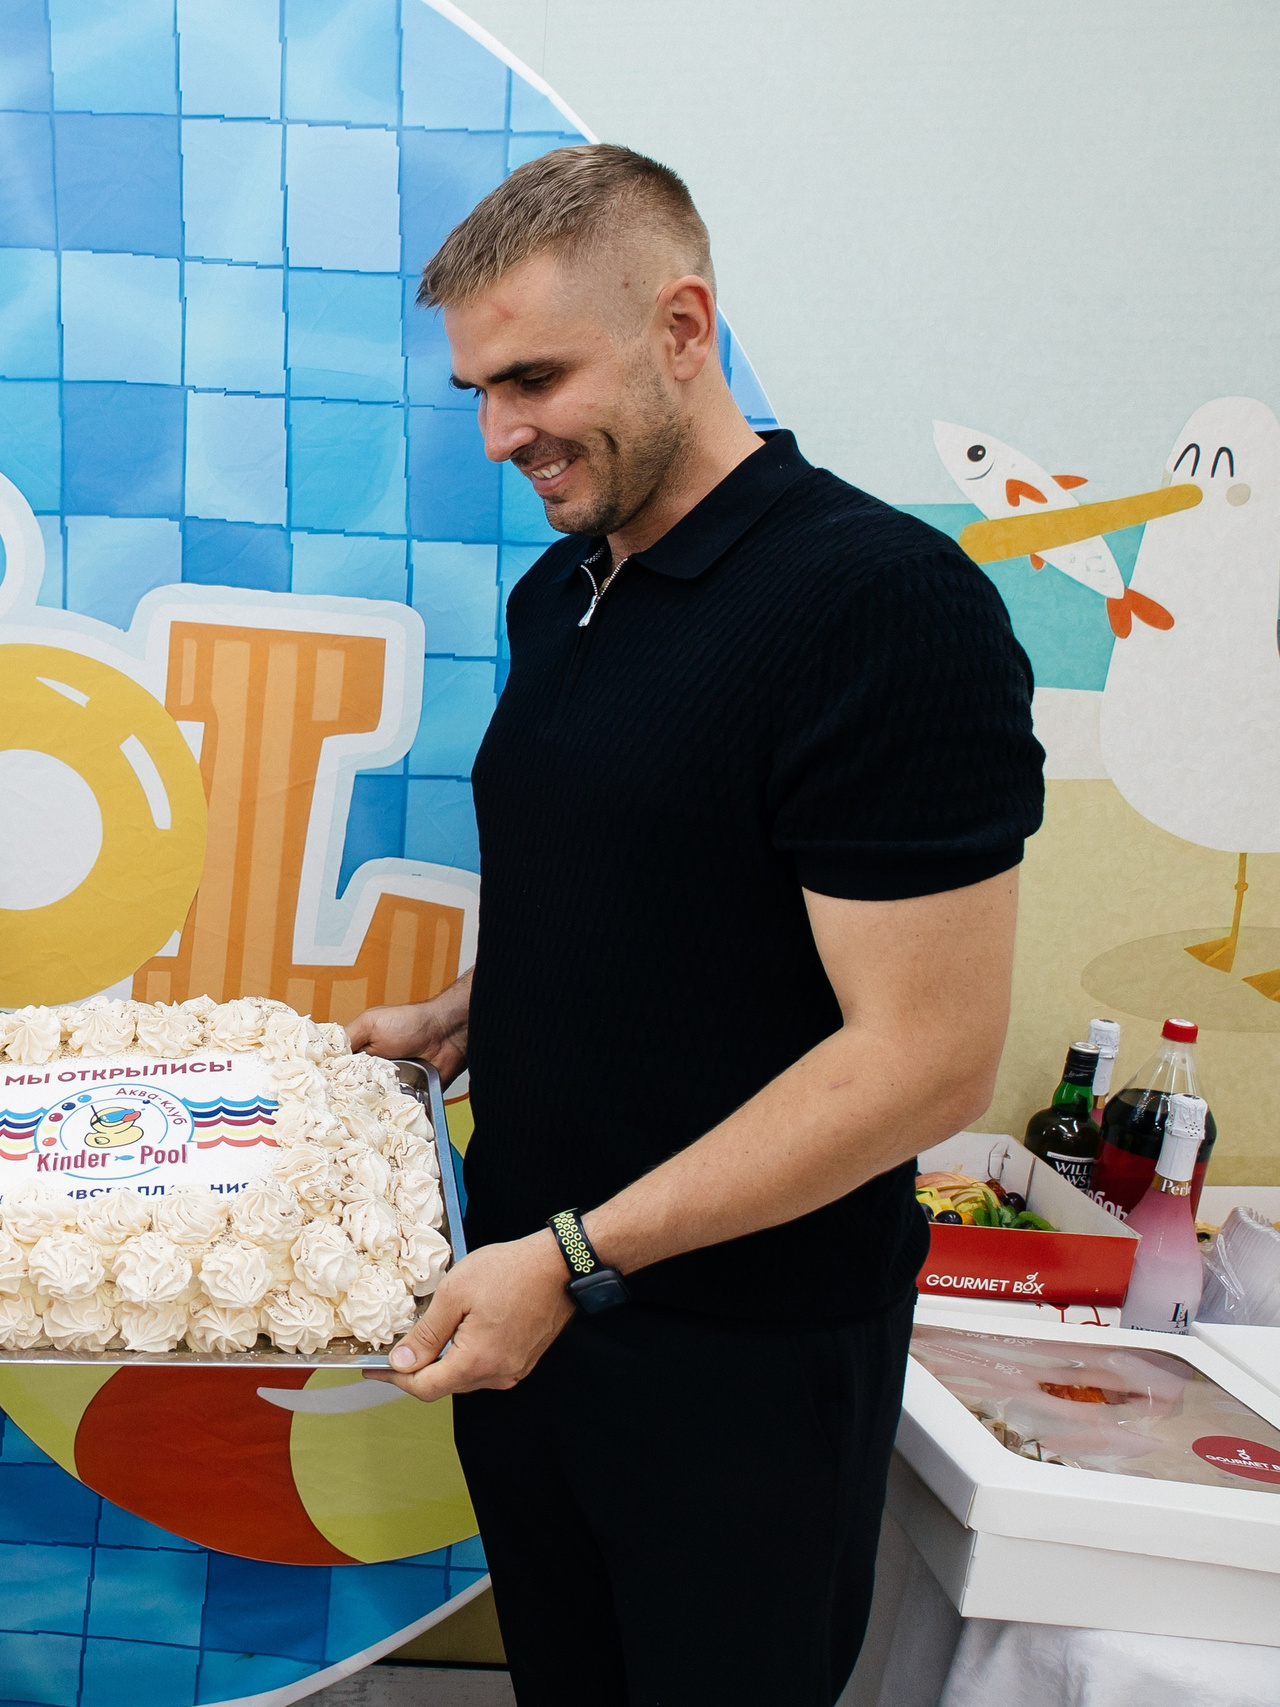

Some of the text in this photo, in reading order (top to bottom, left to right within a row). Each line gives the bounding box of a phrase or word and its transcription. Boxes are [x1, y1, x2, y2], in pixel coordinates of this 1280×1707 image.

[4, 1060, 233, 1086] МЫ ОТКРЫЛИСЬ!
[116, 1087, 188, 1125] Аква-клуб
[37, 1144, 188, 1172] Kinder Pool
[925, 1274, 1045, 1295] GOURMET BOX
